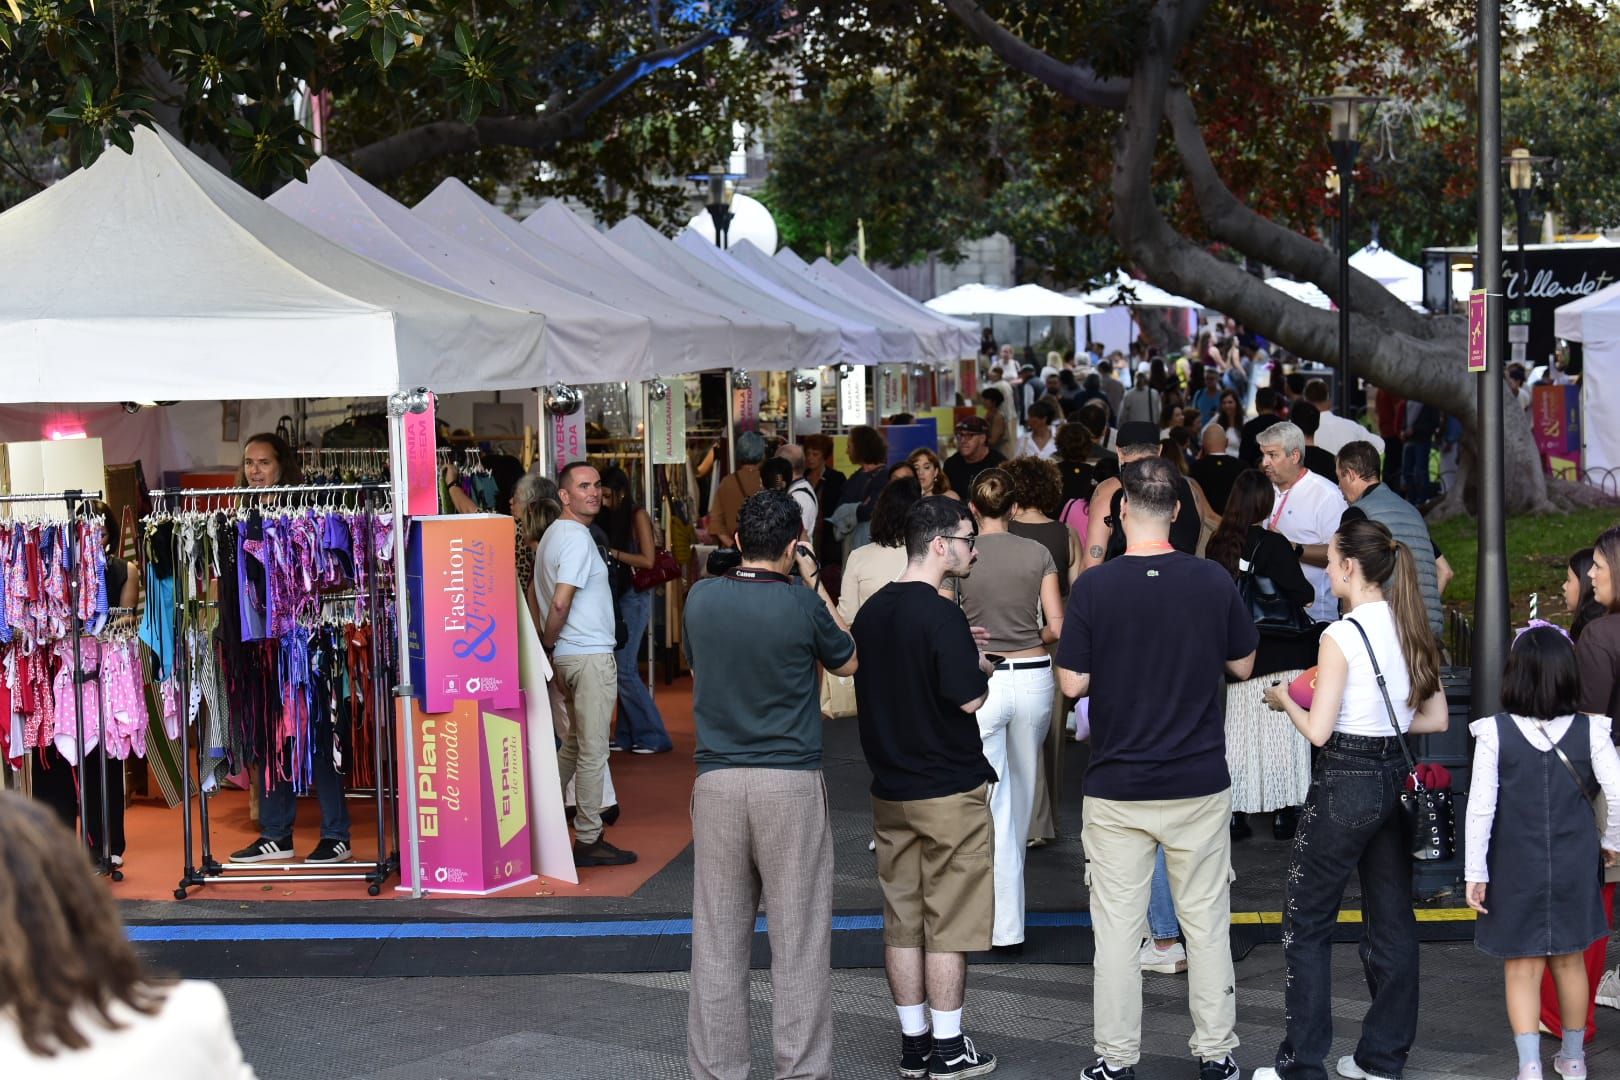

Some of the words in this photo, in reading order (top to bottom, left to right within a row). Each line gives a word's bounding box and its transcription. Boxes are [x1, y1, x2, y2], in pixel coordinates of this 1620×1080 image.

[568, 424, 577, 456] ADA
[443, 536, 465, 633] Fashion
[463, 539, 486, 634] Friends
[452, 614, 497, 663] &
[417, 719, 438, 800] Plan
[440, 720, 459, 781] moda
[501, 736, 510, 791] Plan
[509, 735, 517, 774] moda
[442, 785, 460, 811] de
[502, 794, 511, 816] El
[511, 778, 518, 795] de
[419, 806, 439, 837] El
